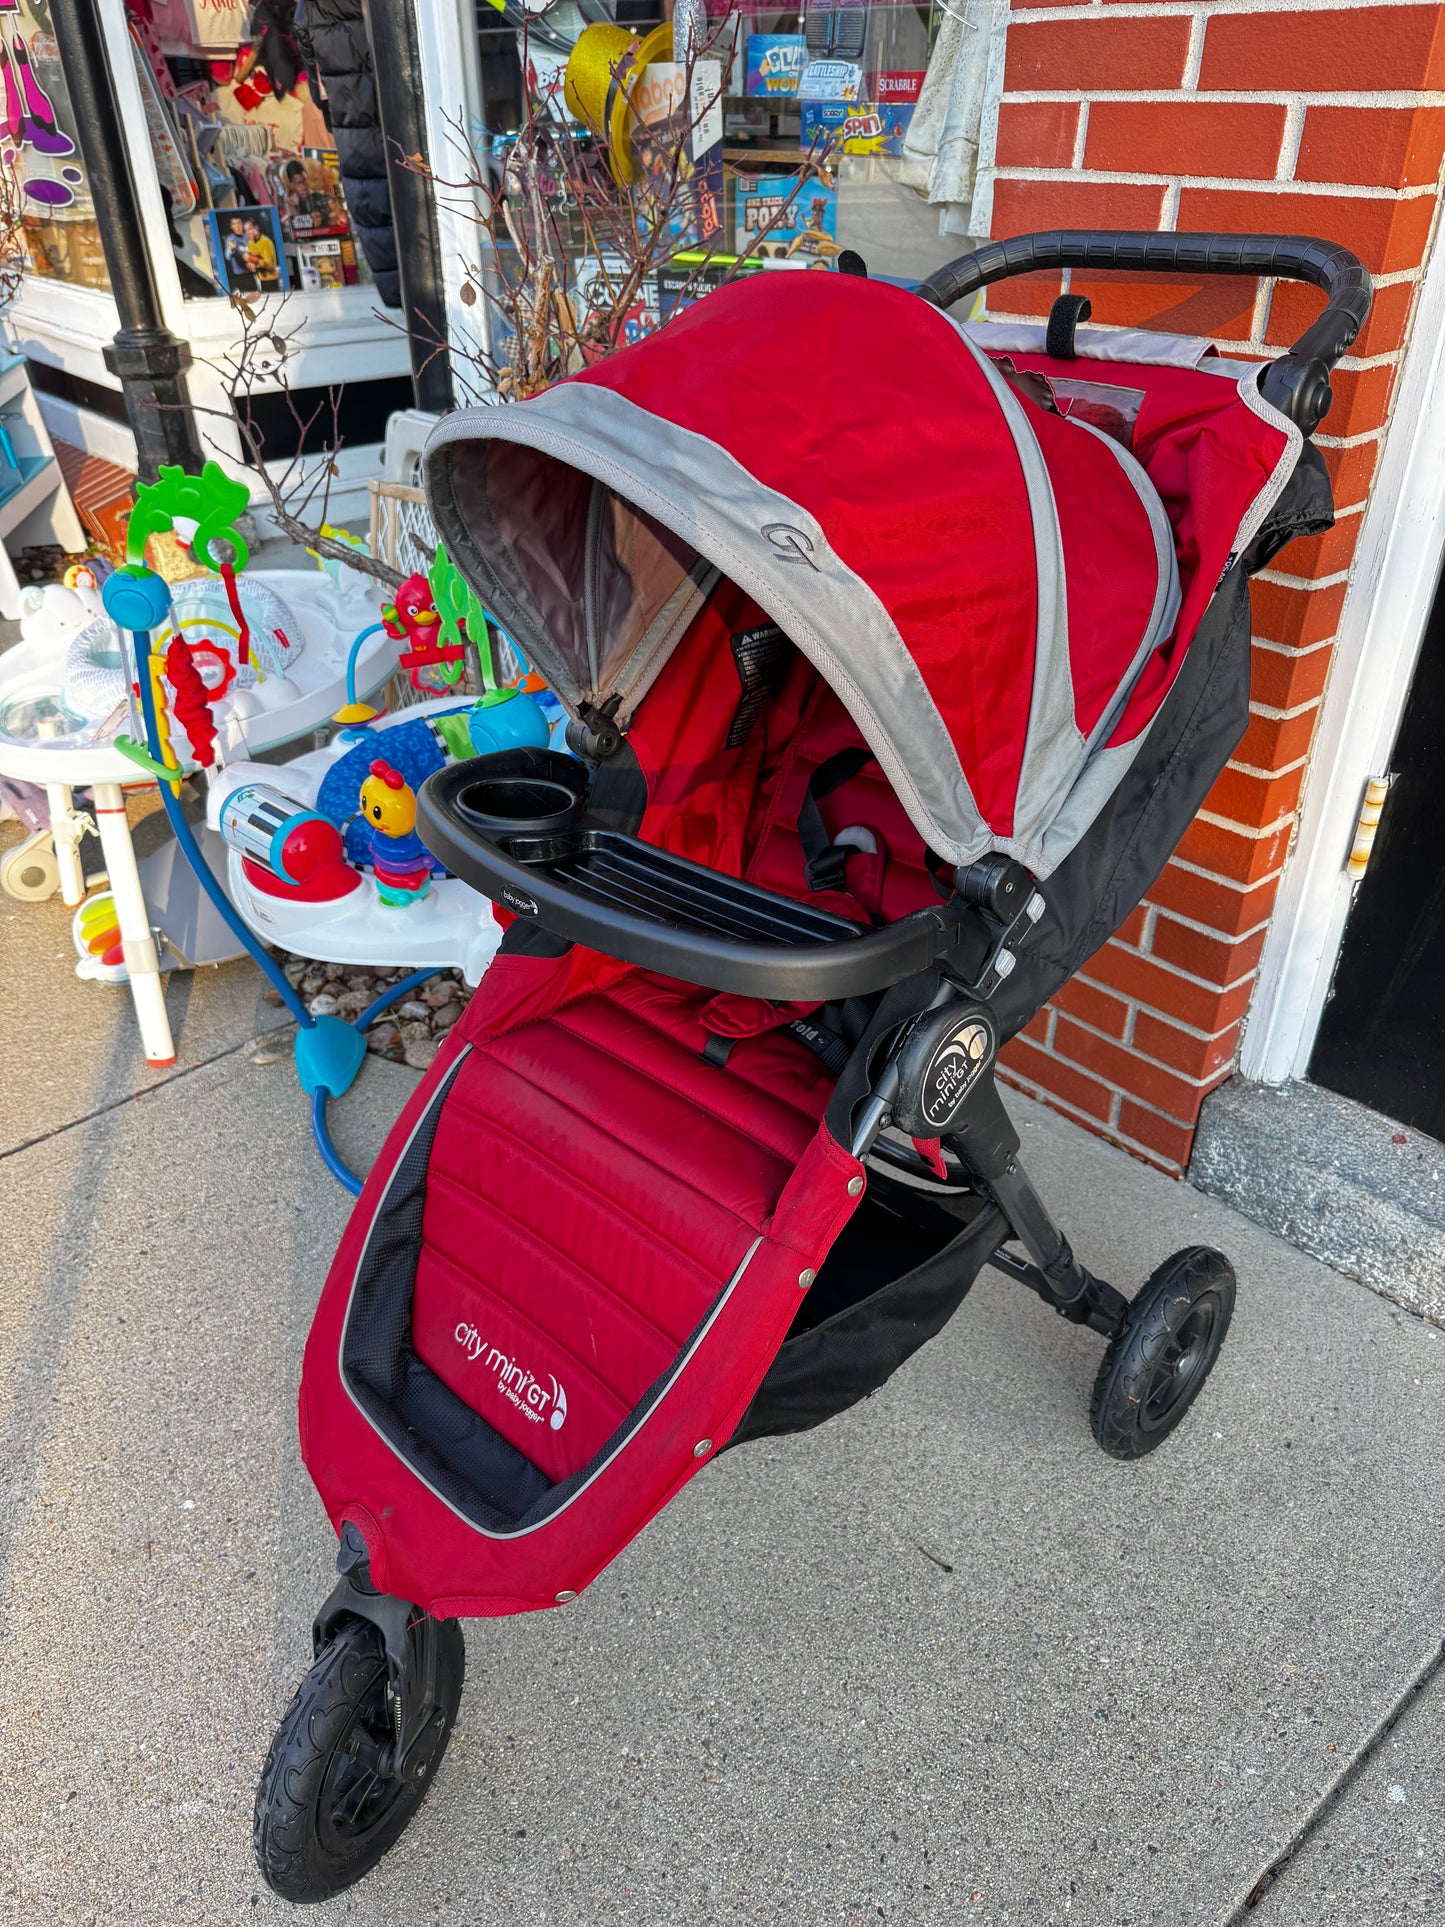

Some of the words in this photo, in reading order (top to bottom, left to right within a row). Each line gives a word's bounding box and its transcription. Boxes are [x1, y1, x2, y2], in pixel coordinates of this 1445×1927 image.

[808, 64, 847, 77] BATTLESHIP
[879, 78, 917, 92] SCRABBLE
[503, 889, 515, 904] baby
[514, 897, 532, 910] jogger
[935, 1056, 958, 1091] city
[929, 1075, 957, 1118] mini
[955, 1060, 969, 1079] GT
[954, 1081, 967, 1098] baby
[453, 1322, 489, 1361] city
[485, 1347, 530, 1395] mini
[527, 1383, 551, 1412] GT
[496, 1380, 507, 1394] by
[505, 1387, 522, 1408] baby
[518, 1400, 542, 1424] jogger
